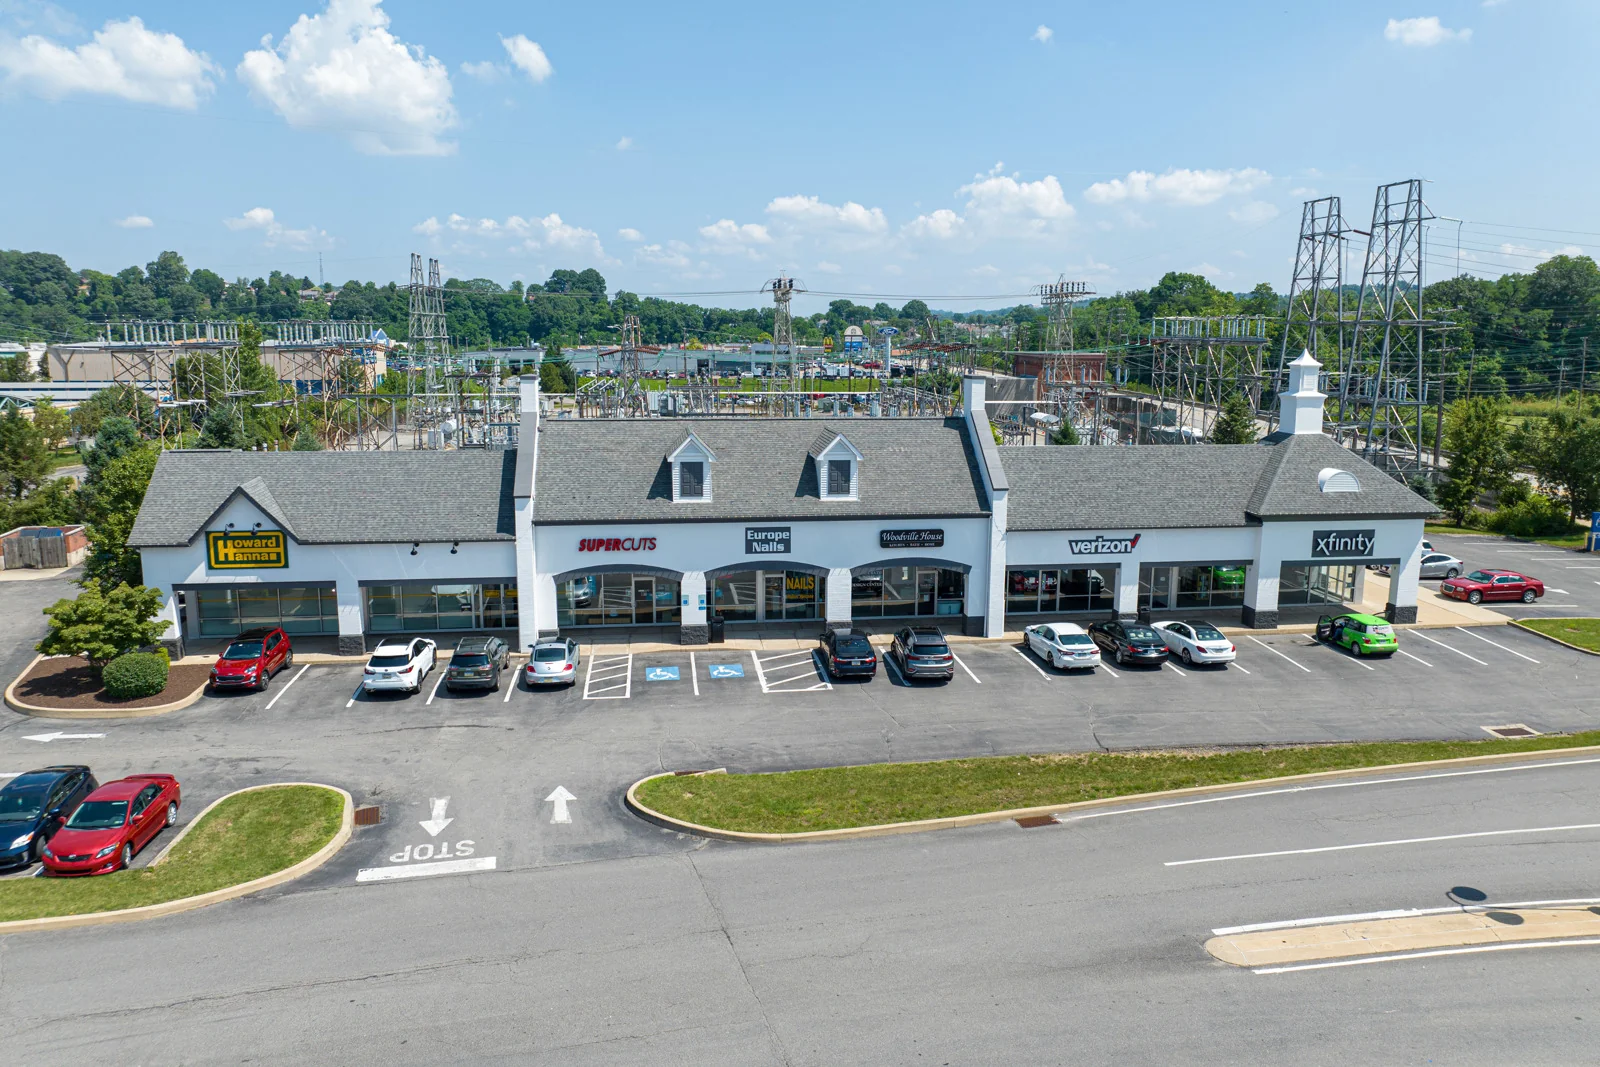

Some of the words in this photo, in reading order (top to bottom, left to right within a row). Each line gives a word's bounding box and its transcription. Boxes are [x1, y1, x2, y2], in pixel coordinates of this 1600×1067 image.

[747, 530, 790, 541] Europe
[881, 532, 919, 541] Woodville
[919, 531, 943, 540] House
[217, 537, 276, 552] Howard
[578, 537, 657, 552] SUPERCUTS
[1071, 538, 1132, 554] verizon
[1316, 534, 1376, 556] xfinity
[217, 547, 268, 561] Hanna
[786, 576, 815, 590] NAILS
[389, 839, 476, 863] STOP
